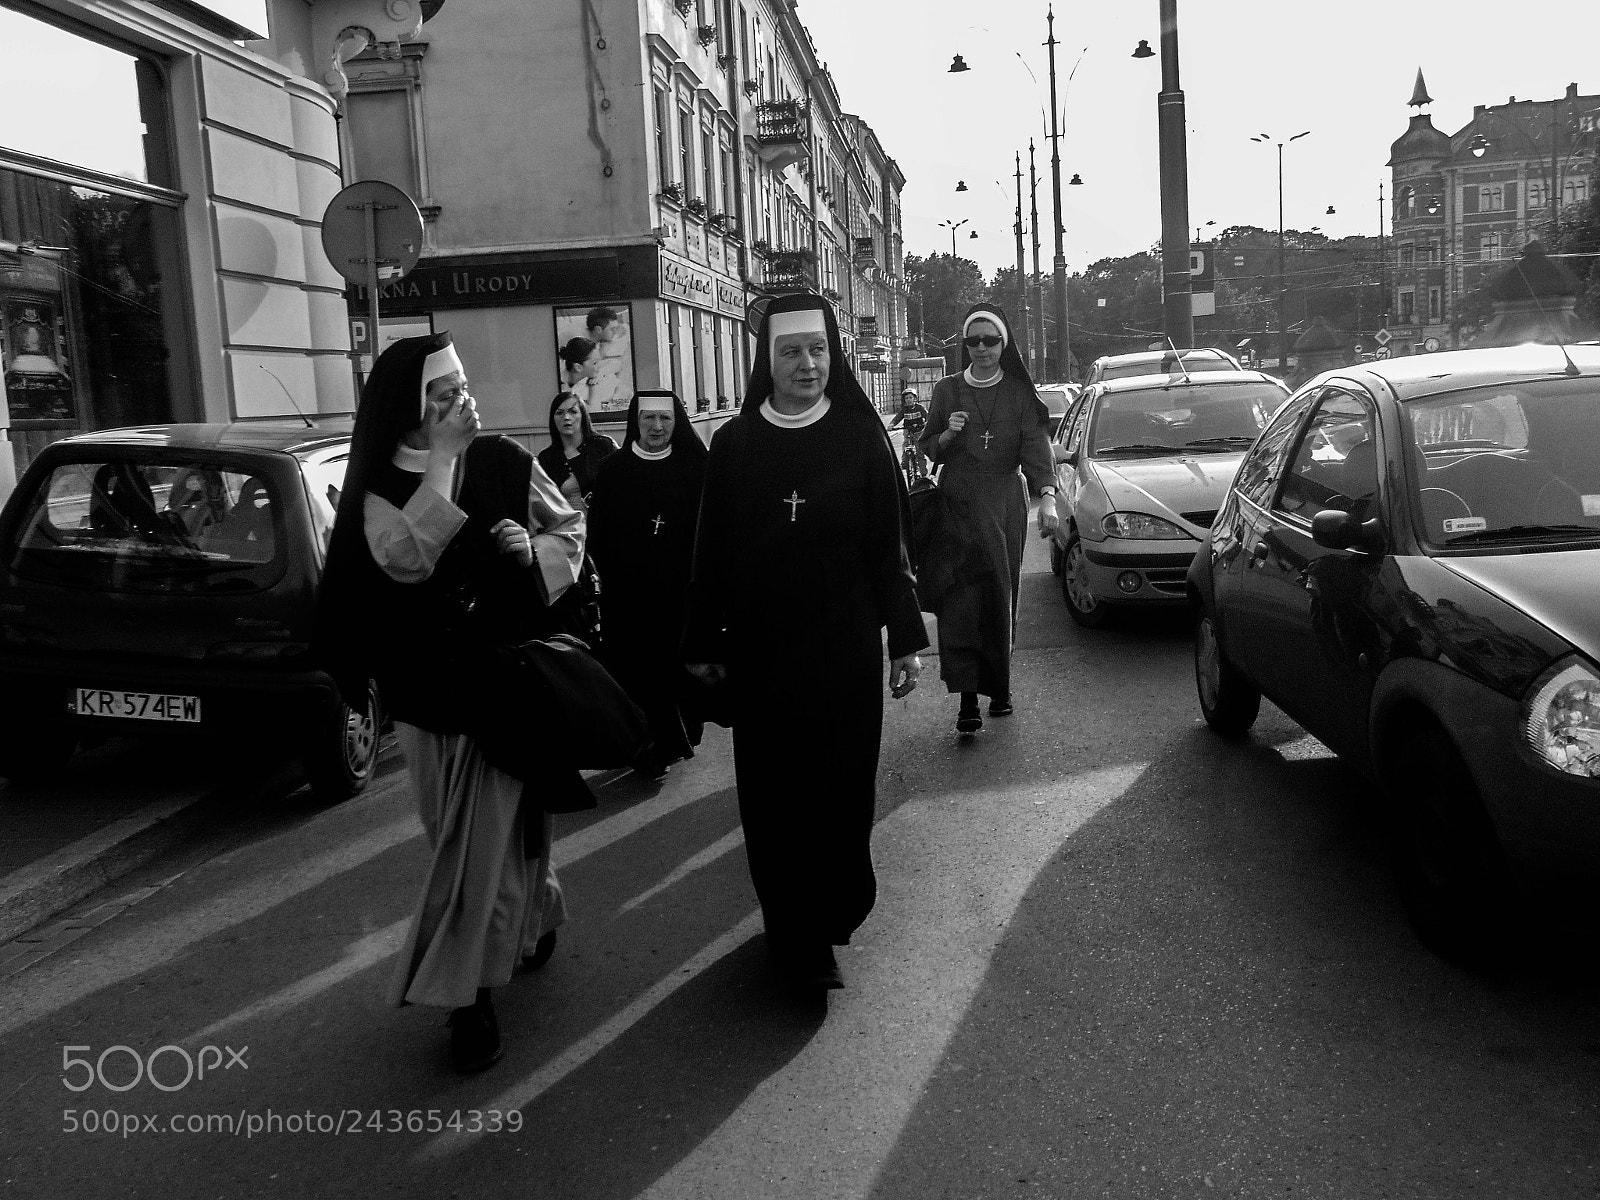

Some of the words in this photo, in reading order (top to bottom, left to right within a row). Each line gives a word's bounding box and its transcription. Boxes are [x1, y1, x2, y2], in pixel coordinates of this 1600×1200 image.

[358, 280, 421, 300] IKNA
[430, 280, 438, 296] I
[452, 271, 533, 295] URODY
[351, 321, 366, 350] P
[81, 690, 114, 714] KR
[123, 693, 197, 720] 574EW
